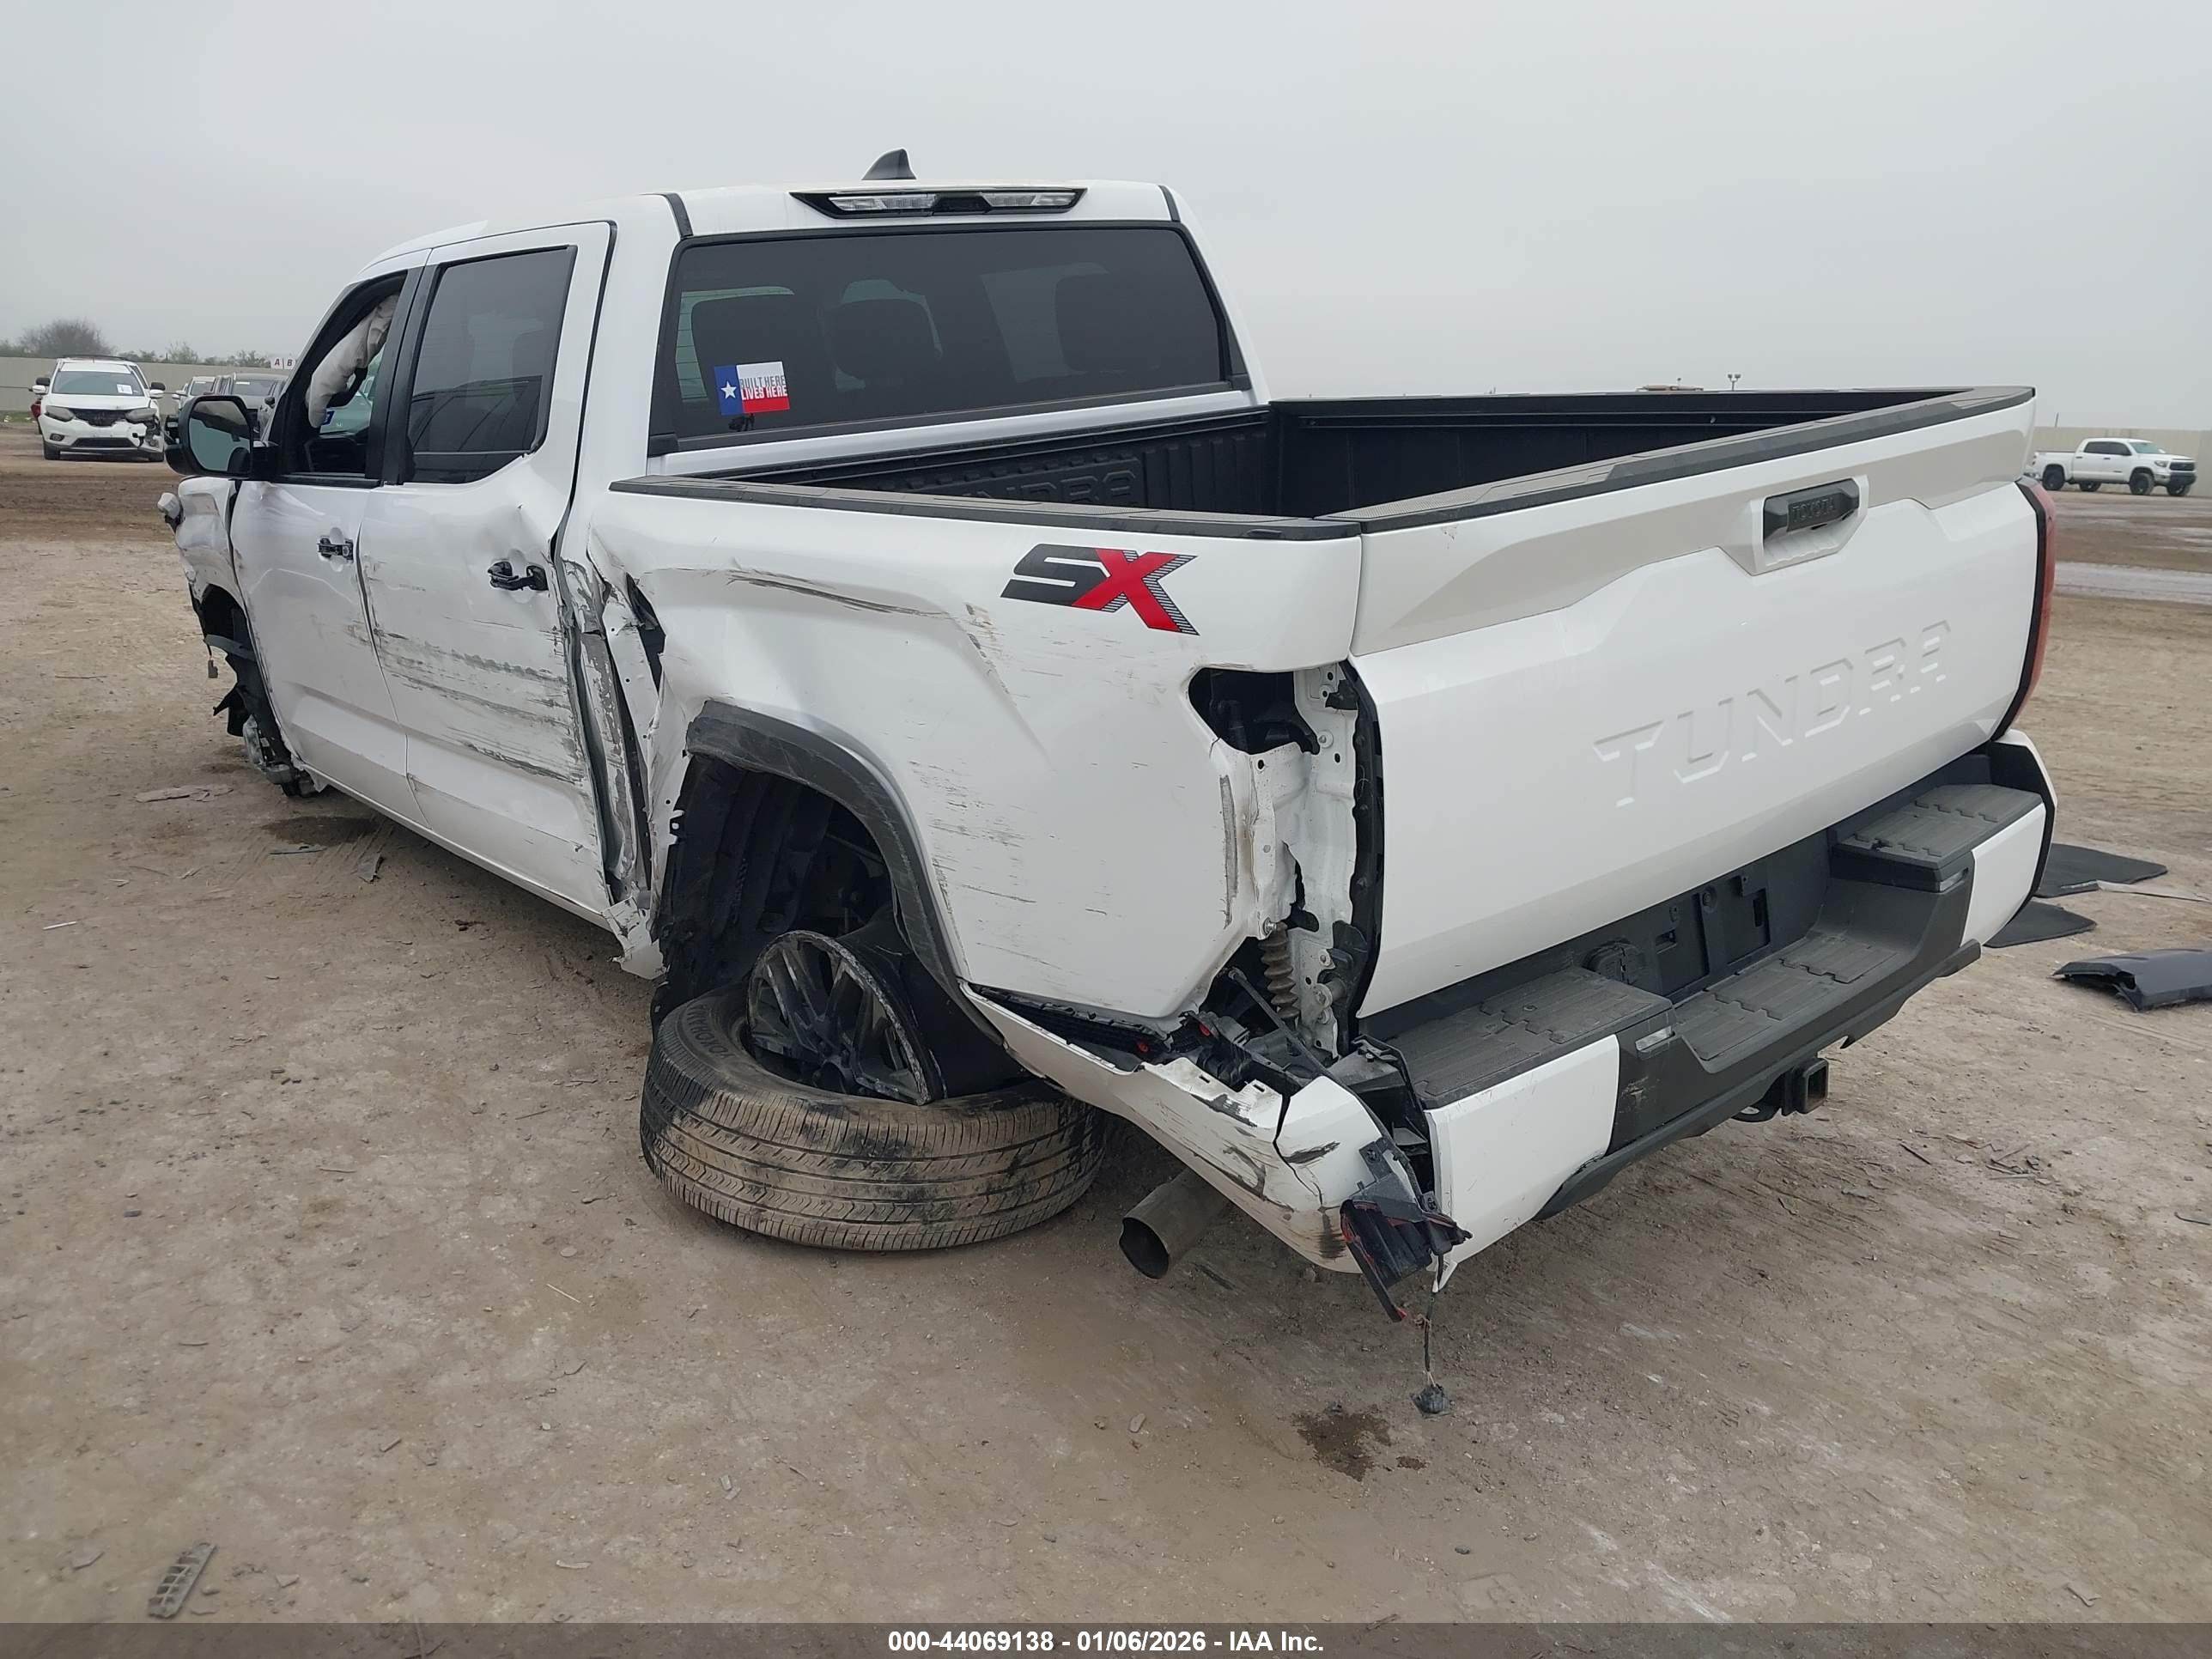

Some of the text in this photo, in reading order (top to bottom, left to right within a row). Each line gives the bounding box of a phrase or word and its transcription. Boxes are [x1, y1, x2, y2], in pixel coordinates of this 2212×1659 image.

[739, 374, 786, 389] BUILT HERE
[741, 385, 788, 401] LIVES HERE
[1792, 495, 1834, 523] TOYOTA
[1592, 619, 1951, 809] TUNDRA
